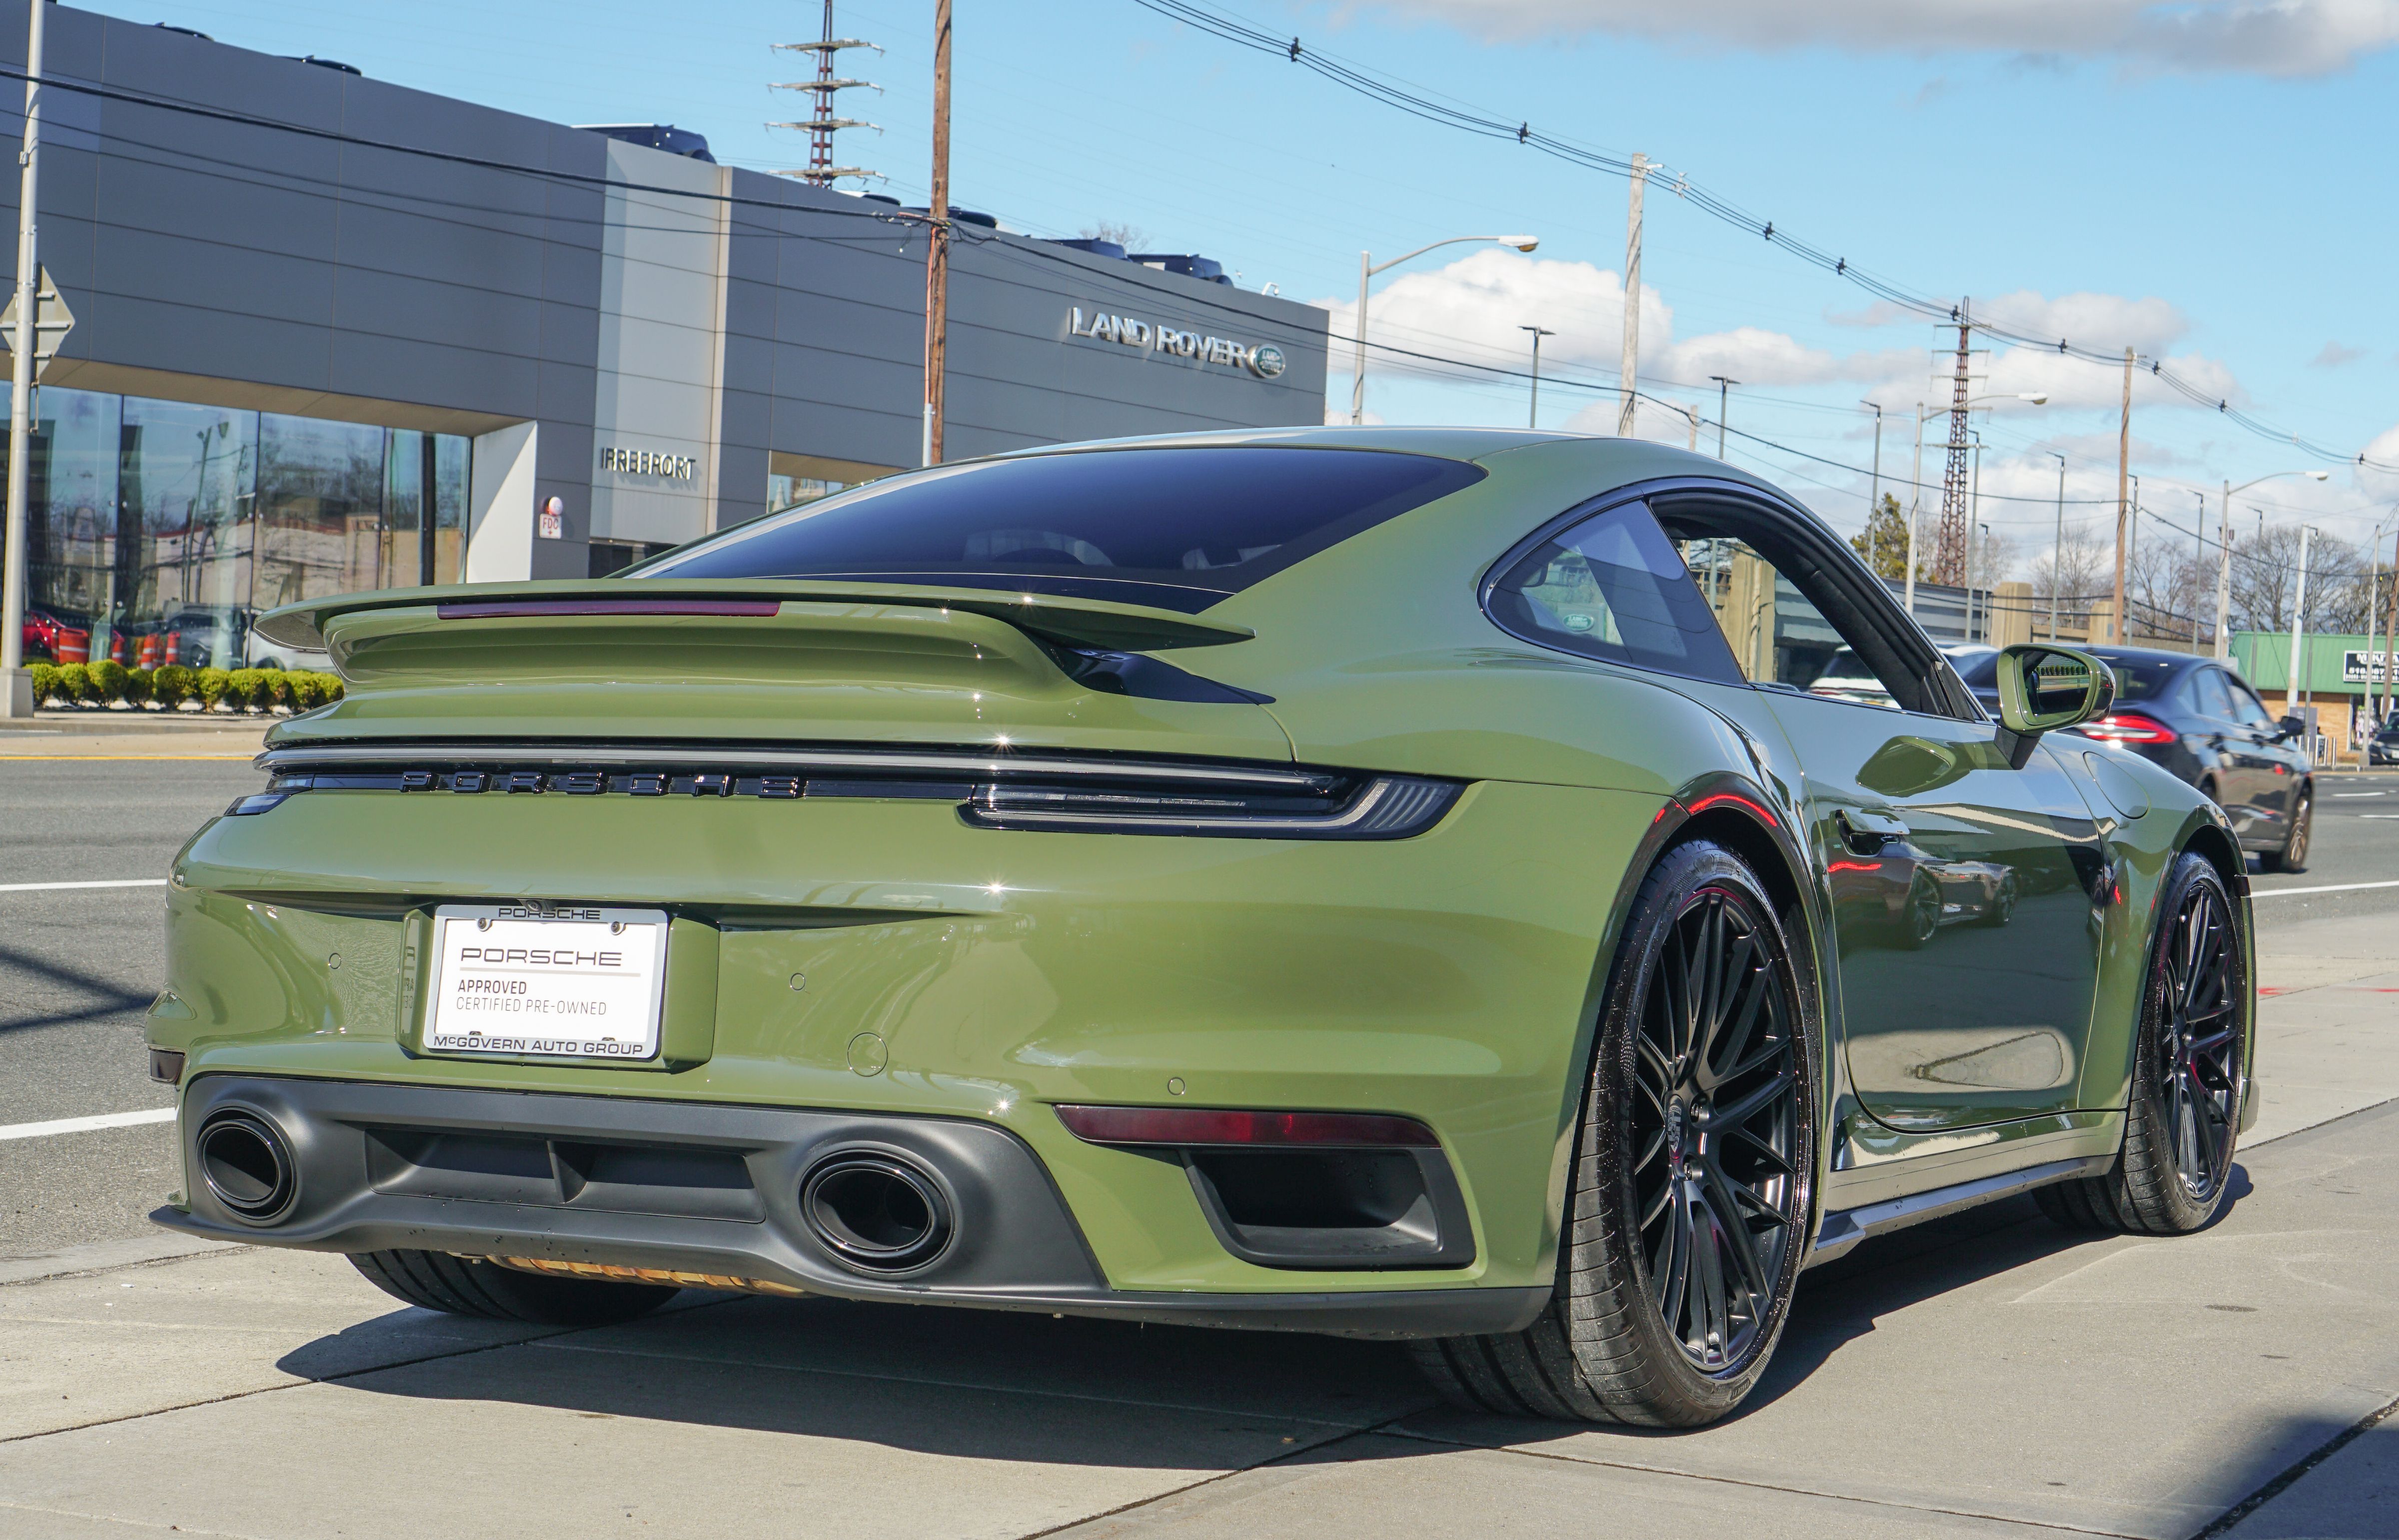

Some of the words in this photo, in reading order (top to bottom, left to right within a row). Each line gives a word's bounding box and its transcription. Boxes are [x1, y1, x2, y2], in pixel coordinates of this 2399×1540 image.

[1072, 307, 1150, 347] LAND
[1156, 325, 1246, 368] ROVER
[602, 447, 696, 480] FREEPORT
[542, 517, 559, 530] FDC
[400, 770, 803, 799] PORSCHE
[499, 907, 601, 920] PORSCHE
[460, 947, 622, 966] PORSCHE
[457, 979, 527, 995] APPROVED
[456, 997, 521, 1012] CERTIFIED
[526, 1000, 607, 1015] PRE-OWNED
[531, 1040, 578, 1053] AUTO
[583, 1042, 643, 1055] GROUP
